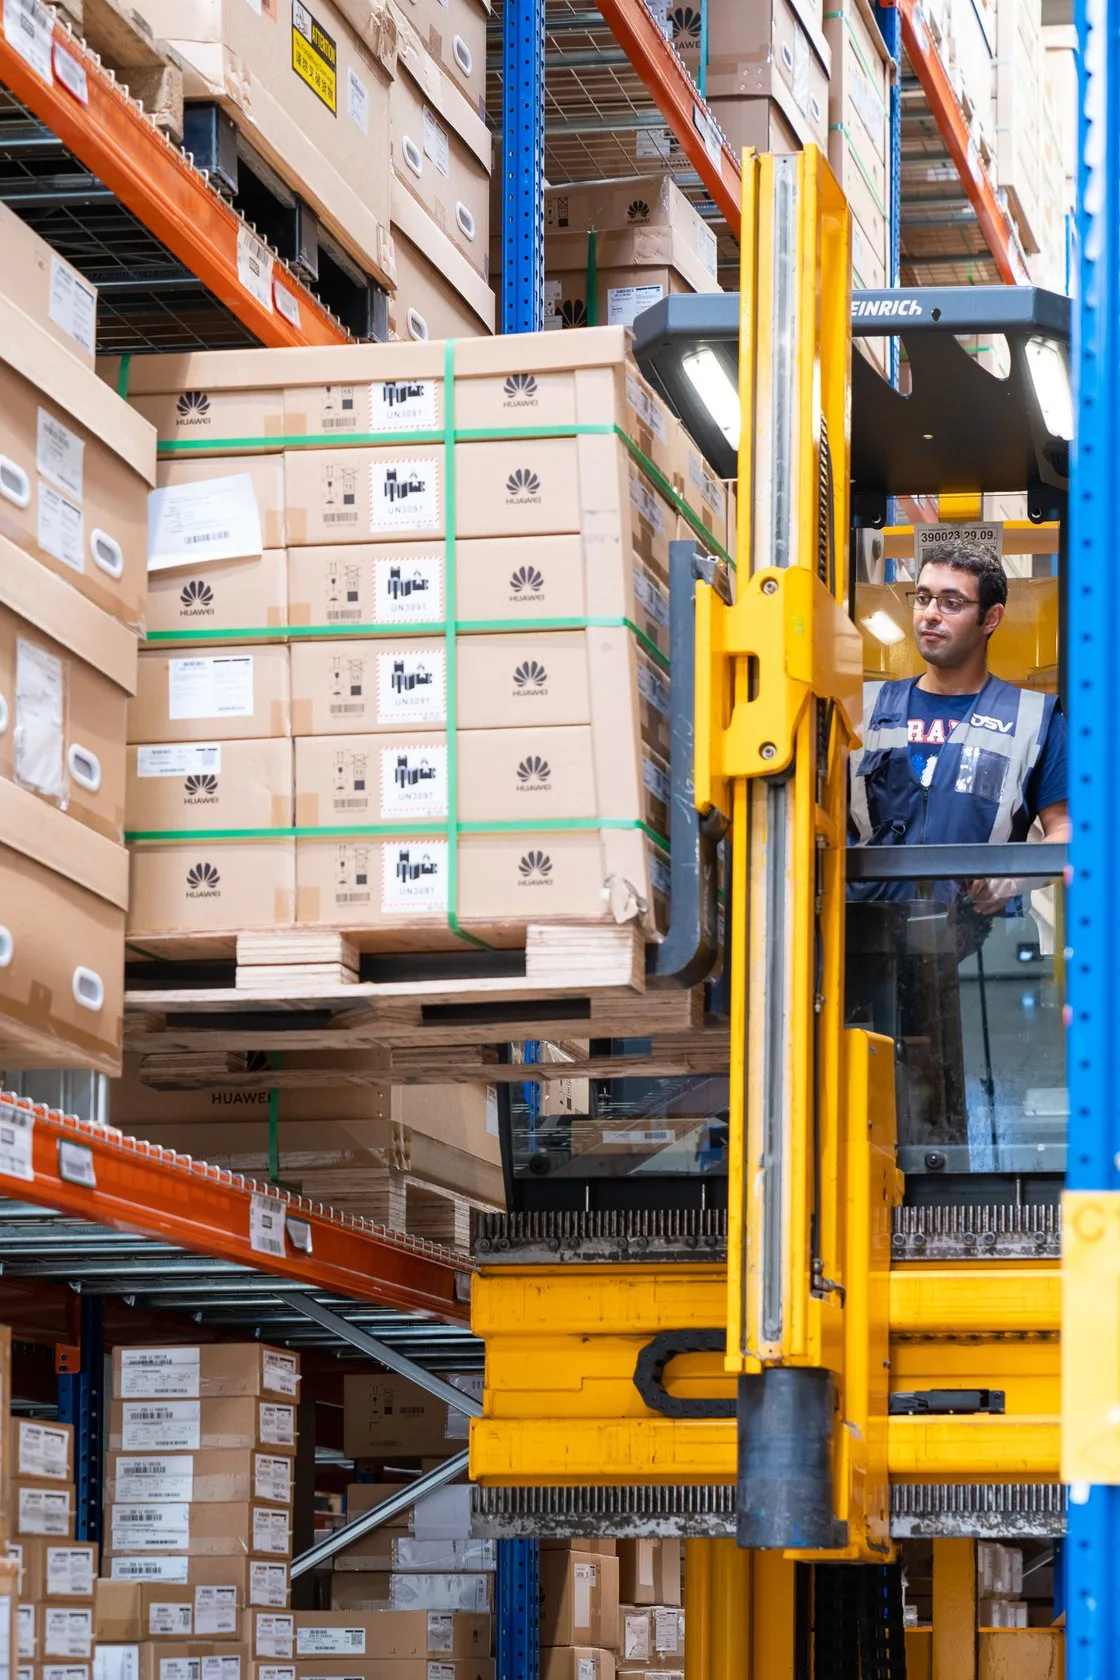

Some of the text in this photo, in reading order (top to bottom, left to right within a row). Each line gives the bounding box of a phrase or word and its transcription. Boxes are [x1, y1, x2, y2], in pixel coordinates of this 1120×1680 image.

[627, 217, 651, 225] HUAWEI
[503, 399, 539, 408] HUAWEI
[176, 418, 211, 426] HUAWEI
[505, 496, 541, 504] HUAWEI
[921, 530, 960, 542] 390023
[509, 593, 545, 601] HUAWEI
[180, 607, 215, 616] HUAWEI
[512, 688, 548, 696] HUAWEI
[970, 712, 1014, 733] DSV
[516, 783, 551, 791] HUAWEI
[518, 878, 554, 886] HUAWEI
[212, 1091, 271, 1104] HUAWEI
